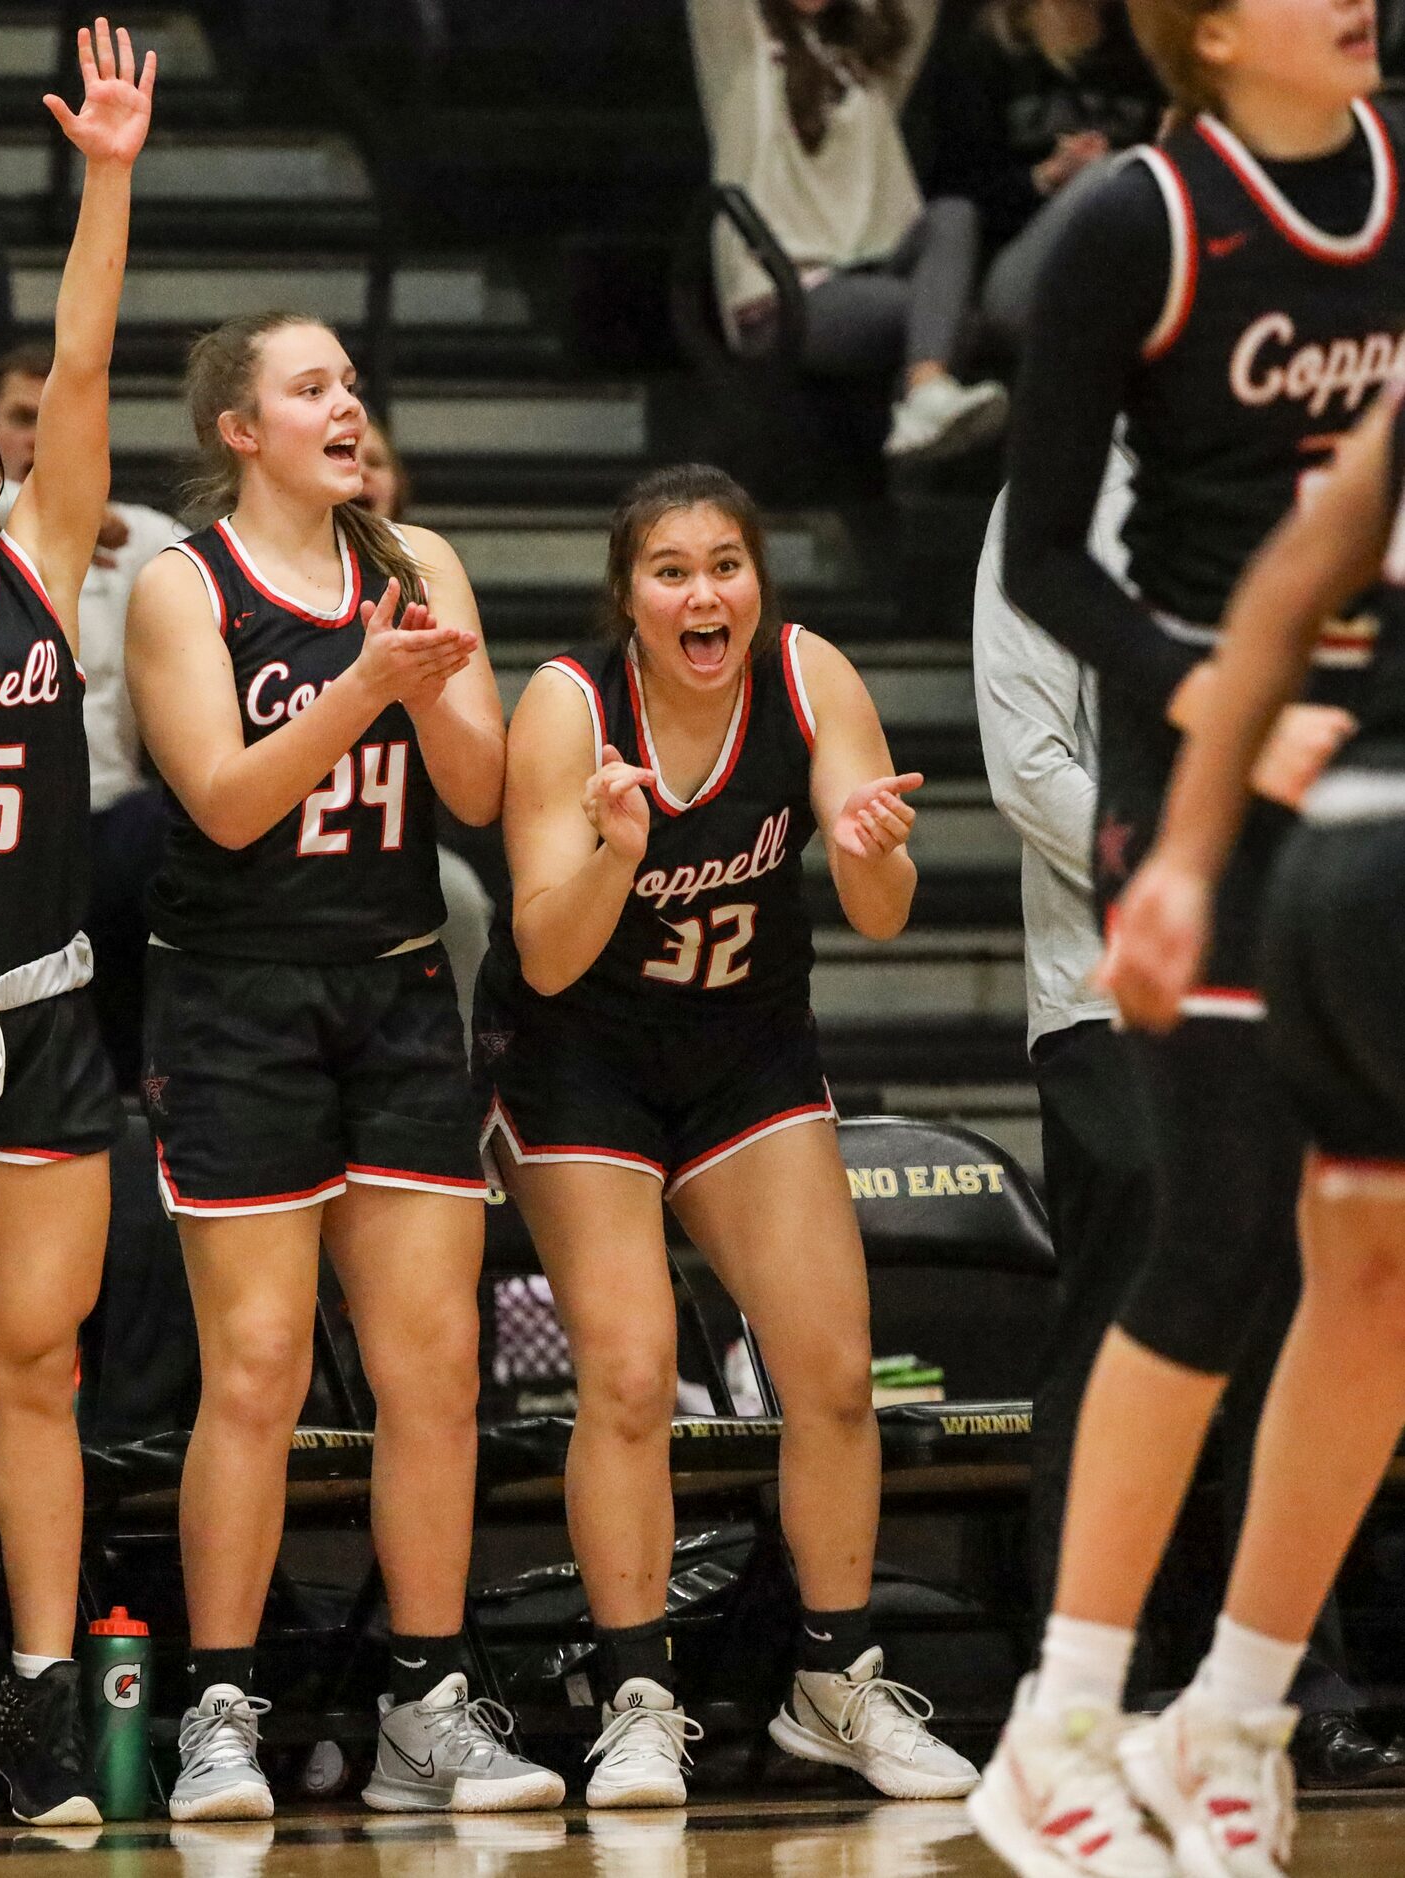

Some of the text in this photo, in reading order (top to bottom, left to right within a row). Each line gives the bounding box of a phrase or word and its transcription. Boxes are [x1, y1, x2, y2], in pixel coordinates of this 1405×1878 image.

[296, 740, 409, 858] 24
[631, 806, 790, 911] oppell
[640, 901, 759, 990] 32
[904, 1163, 1005, 1197] EAST
[939, 1412, 1033, 1436] WINNIN
